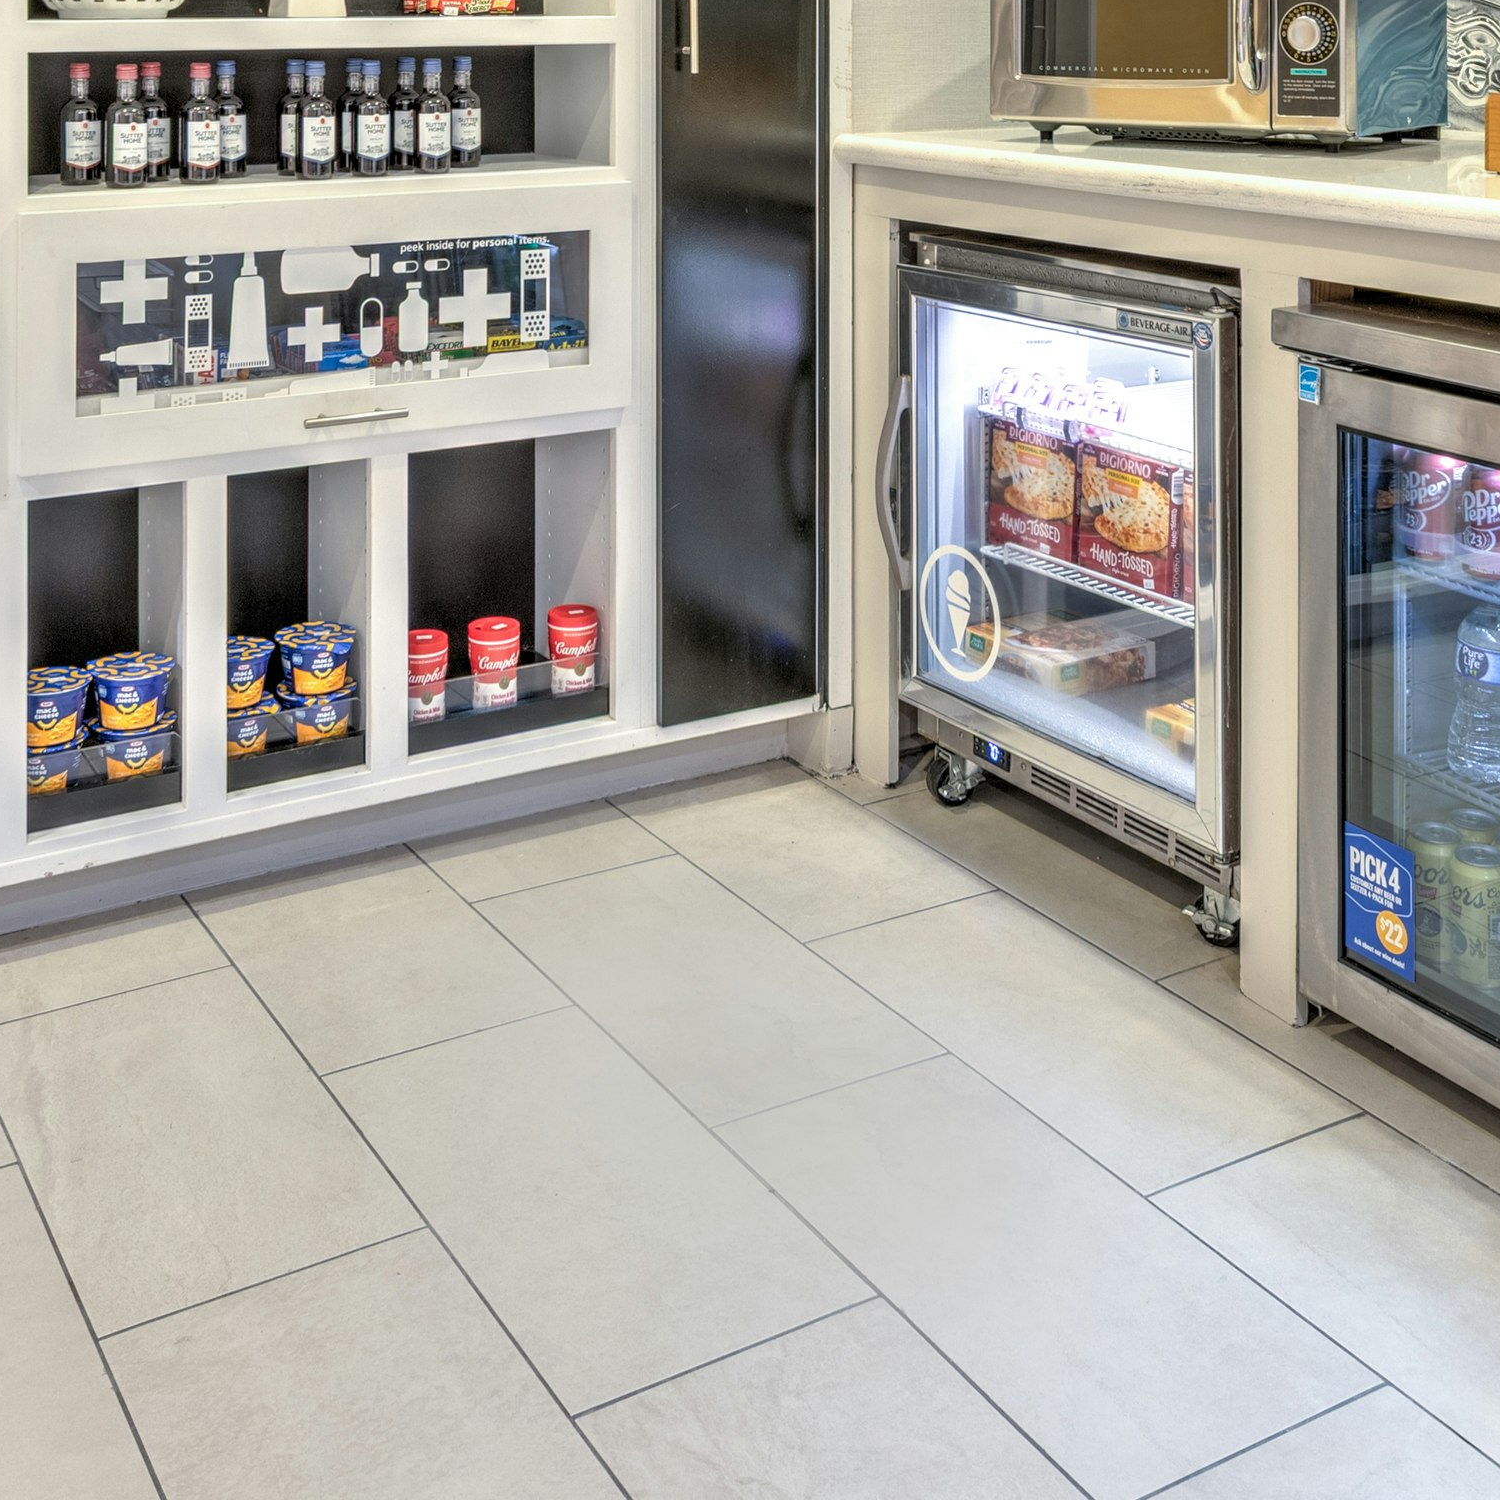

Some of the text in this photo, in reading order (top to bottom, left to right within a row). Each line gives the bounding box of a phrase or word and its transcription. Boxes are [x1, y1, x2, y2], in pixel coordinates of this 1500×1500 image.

[401, 235, 550, 254] peek inside for personal items.
[1130, 317, 1190, 337] BEVERAGE-AIR
[427, 341, 464, 351] EXCEDRI
[1475, 489, 1500, 508] Dr
[1469, 531, 1483, 546] 23
[1090, 543, 1154, 579] HAND-TOSSED
[1462, 645, 1484, 660] Pure
[1463, 657, 1481, 670] Life
[1349, 845, 1400, 894] PICK 4
[1350, 873, 1373, 892] CUSTOMIZE
[1374, 884, 1383, 896] ANY
[1383, 889, 1395, 902] BEER
[1384, 898, 1394, 910] FOR
[1380, 916, 1404, 950] $22
